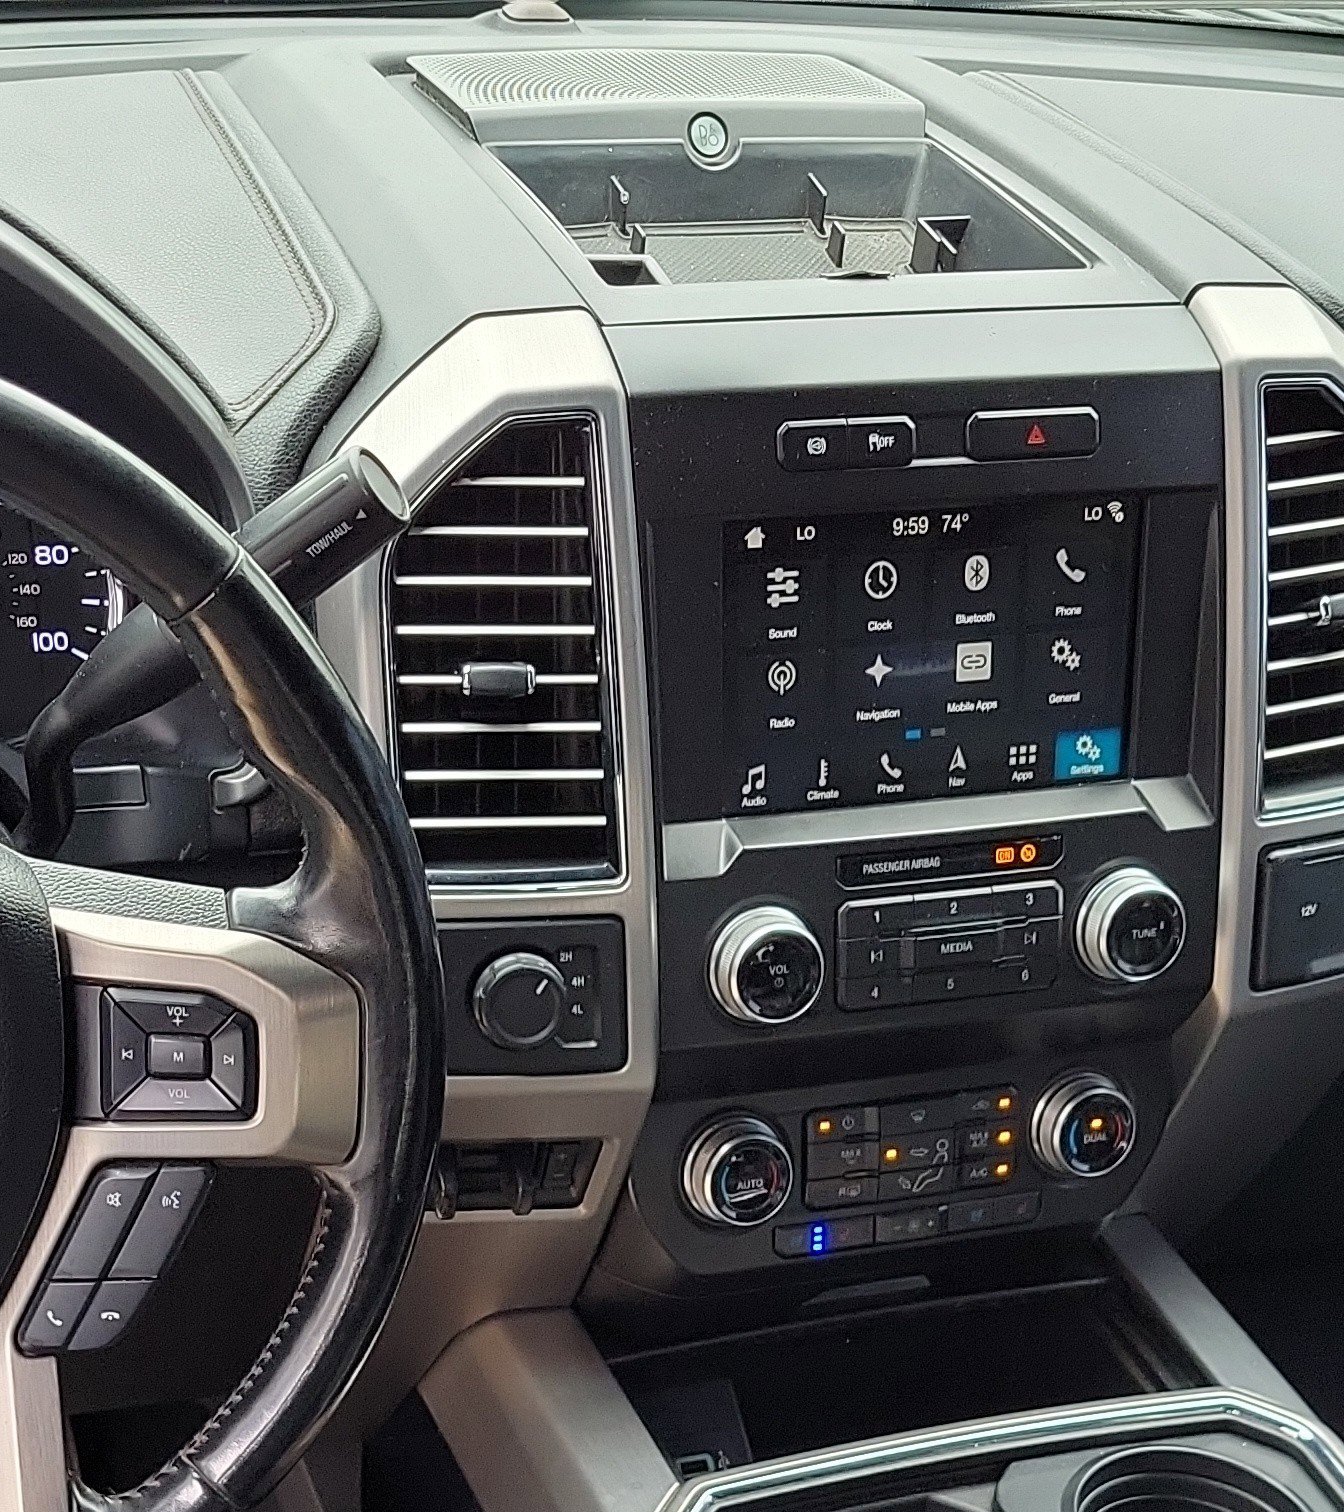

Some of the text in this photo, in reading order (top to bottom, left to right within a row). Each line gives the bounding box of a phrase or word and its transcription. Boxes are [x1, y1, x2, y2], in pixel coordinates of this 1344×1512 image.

[879, 435, 895, 448] OFF
[1084, 506, 1103, 521] LO
[893, 516, 929, 536] 9:59
[306, 521, 353, 557] TOW/HAUL
[796, 526, 816, 541] LO
[8, 553, 28, 565] 120
[34, 545, 69, 565] 80
[19, 583, 41, 596] 140
[955, 611, 995, 625] Bluetooth
[1055, 606, 1082, 617] Phone
[16, 616, 38, 629] 160
[867, 620, 893, 632] Clock
[768, 627, 798, 639] Sound
[32, 632, 69, 652] 100
[1048, 692, 1080, 704] General
[946, 700, 998, 713] Mobile Apps
[856, 708, 900, 722] Navigation
[769, 717, 795, 729] Radio
[1011, 770, 1034, 782] Apps
[1070, 764, 1104, 775] Settings
[877, 783, 904, 794] Phone
[948, 776, 965, 788] Nav
[806, 789, 839, 801] Climate
[741, 796, 767, 808] Audio
[863, 856, 940, 875] PASSENGER AIRBAG
[1025, 892, 1034, 906] 3
[949, 901, 958, 915] 2
[1301, 903, 1318, 917] 12V
[873, 910, 880, 923] 1
[1131, 927, 1158, 940] TUNE
[940, 940, 973, 955] MEDIA
[768, 964, 790, 976] VOL
[571, 975, 585, 988] 4H
[946, 978, 955, 990] 5
[870, 985, 879, 999] 4
[166, 1006, 189, 1017] VOL
[571, 1003, 584, 1015] 4L
[173, 1051, 184, 1063] M
[168, 1088, 190, 1099] VOL
[1083, 1132, 1107, 1145] DUAL
[736, 1177, 764, 1190] AUTO
